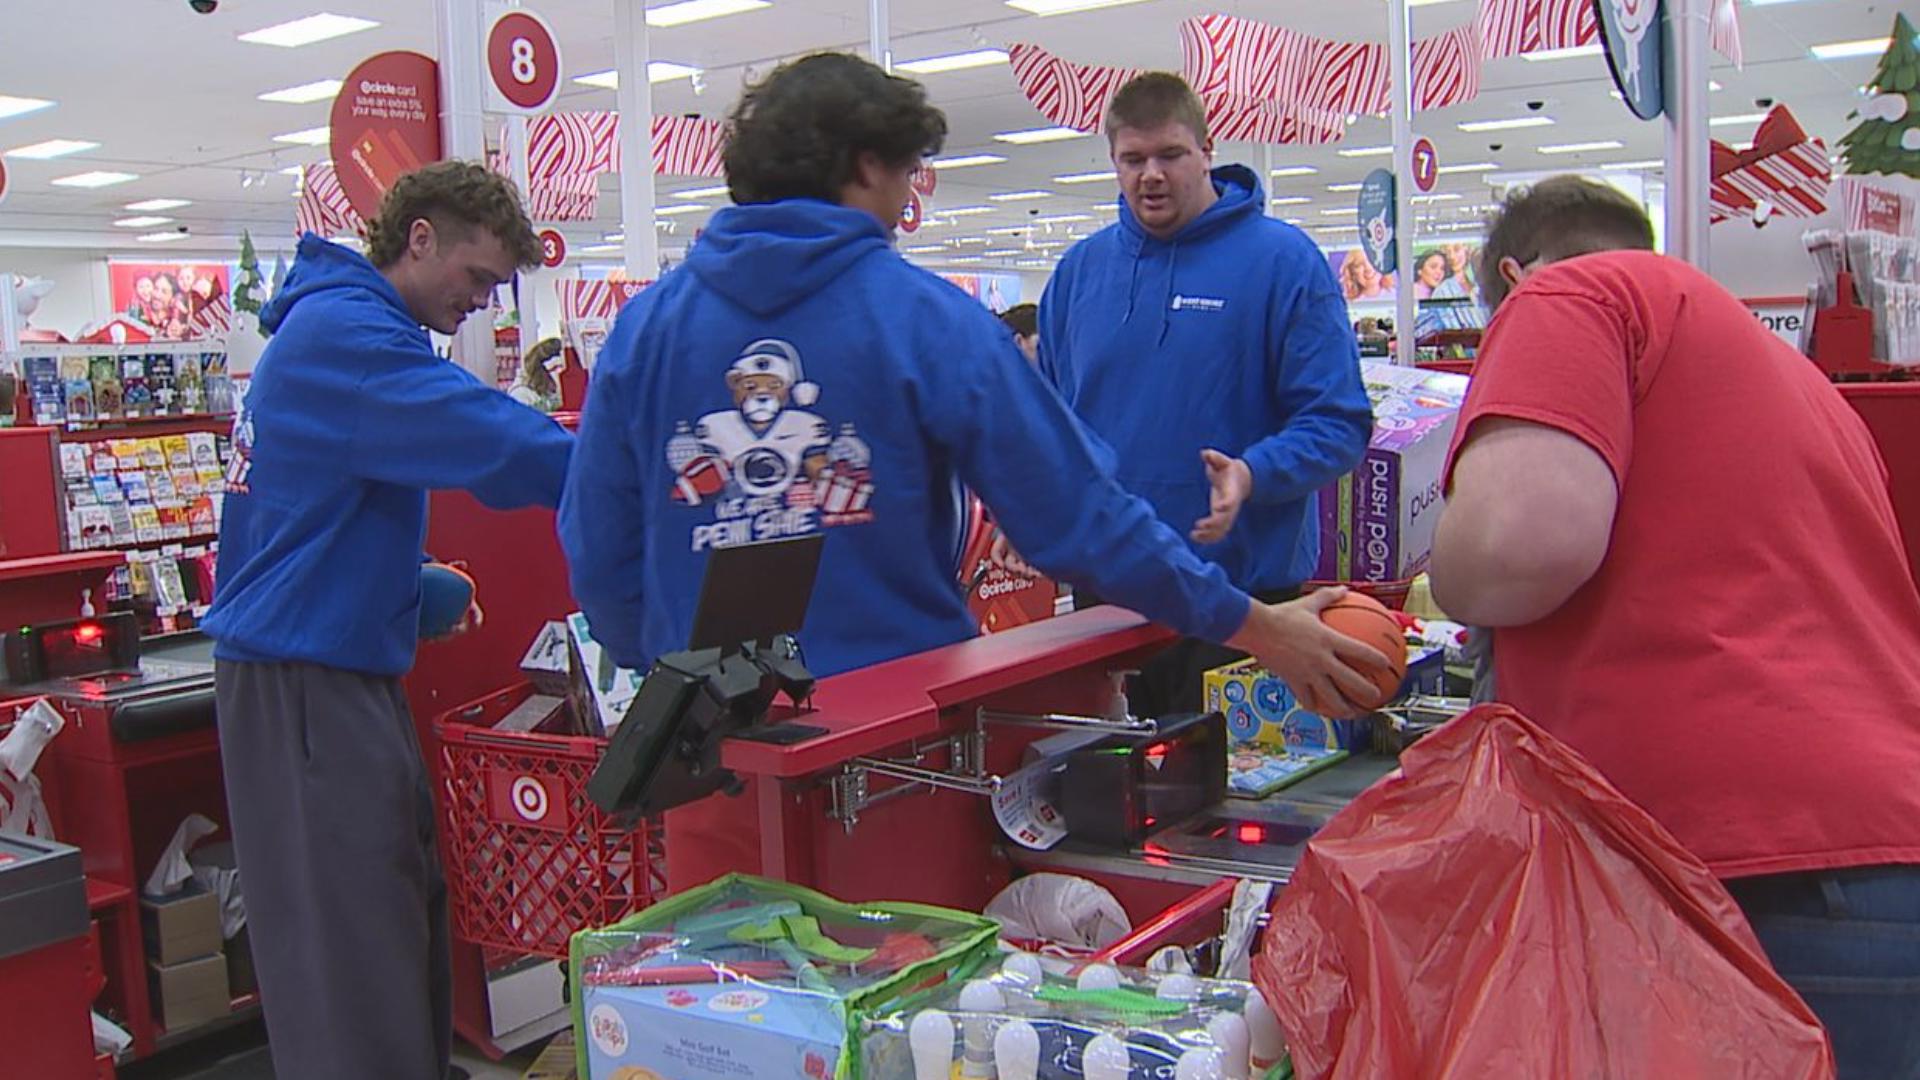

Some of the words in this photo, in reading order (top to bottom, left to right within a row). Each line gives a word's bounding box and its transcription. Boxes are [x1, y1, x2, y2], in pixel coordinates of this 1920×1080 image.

[512, 37, 536, 83] 8
[1418, 151, 1430, 179] 7
[544, 239, 556, 259] 3
[1753, 310, 1804, 332] ore.
